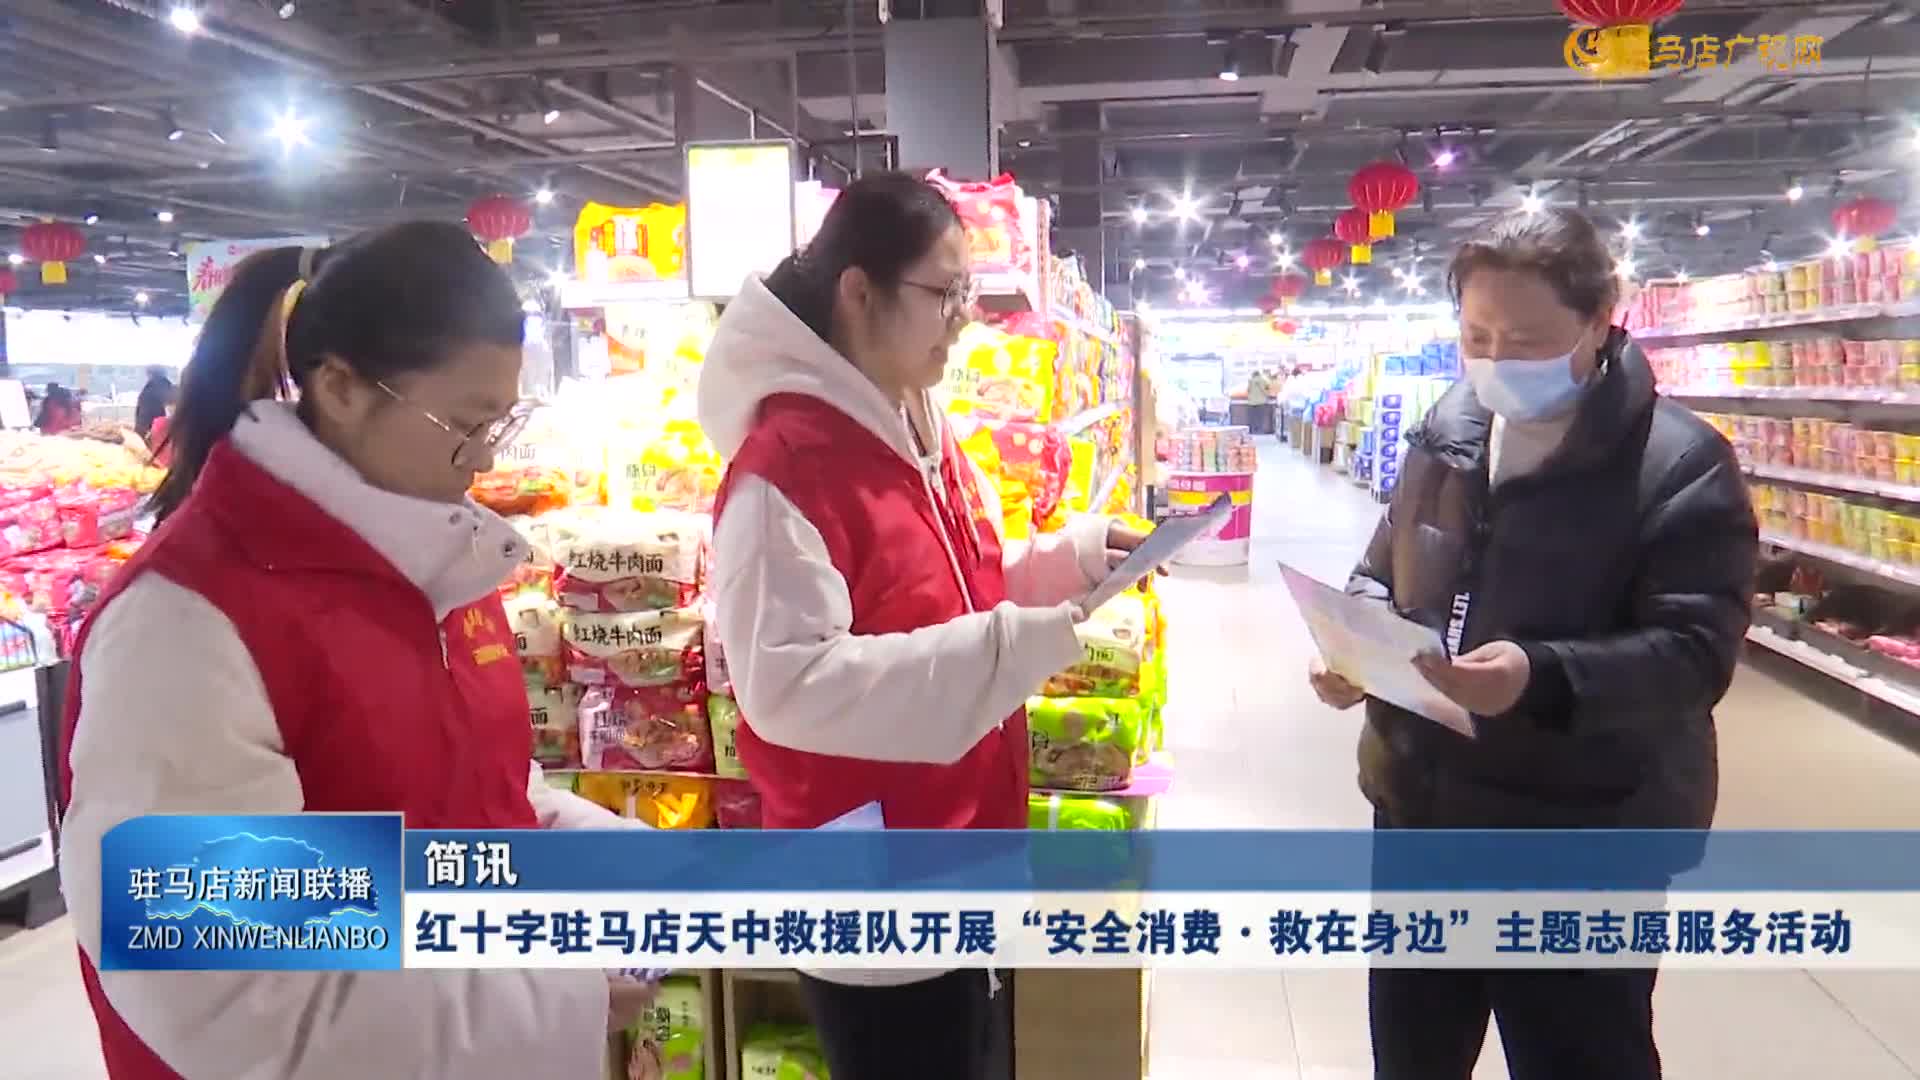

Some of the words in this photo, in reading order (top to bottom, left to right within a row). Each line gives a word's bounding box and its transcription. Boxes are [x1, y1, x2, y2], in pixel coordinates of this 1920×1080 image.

[568, 550, 664, 574] 红烧牛肉面
[573, 624, 663, 646] 红烧牛肉面
